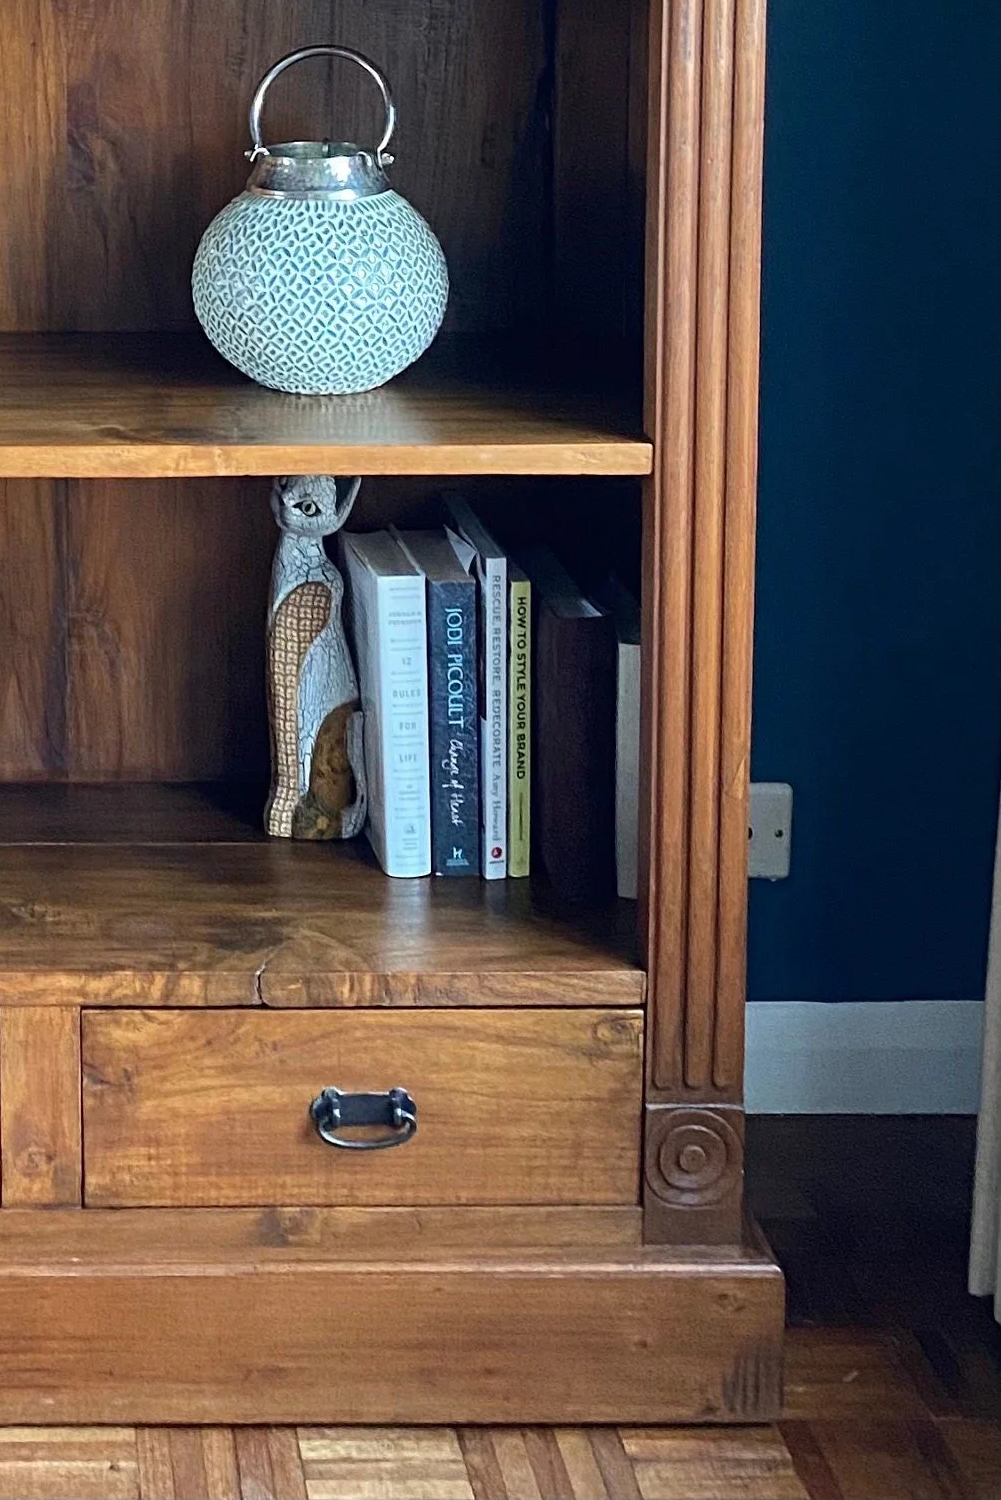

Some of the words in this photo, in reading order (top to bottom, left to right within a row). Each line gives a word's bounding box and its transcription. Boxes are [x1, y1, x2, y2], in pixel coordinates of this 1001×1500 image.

[445, 607, 463, 646] JODI
[516, 596, 527, 629] HOW
[516, 631, 527, 650] TO
[516, 652, 527, 692] STYLE
[392, 688, 421, 699] RULES
[447, 653, 464, 730] PICOULT
[399, 721, 417, 731] FOR
[491, 689, 502, 768] REDECORATE
[516, 693, 527, 731] YOUR
[516, 733, 527, 780] BRAND
